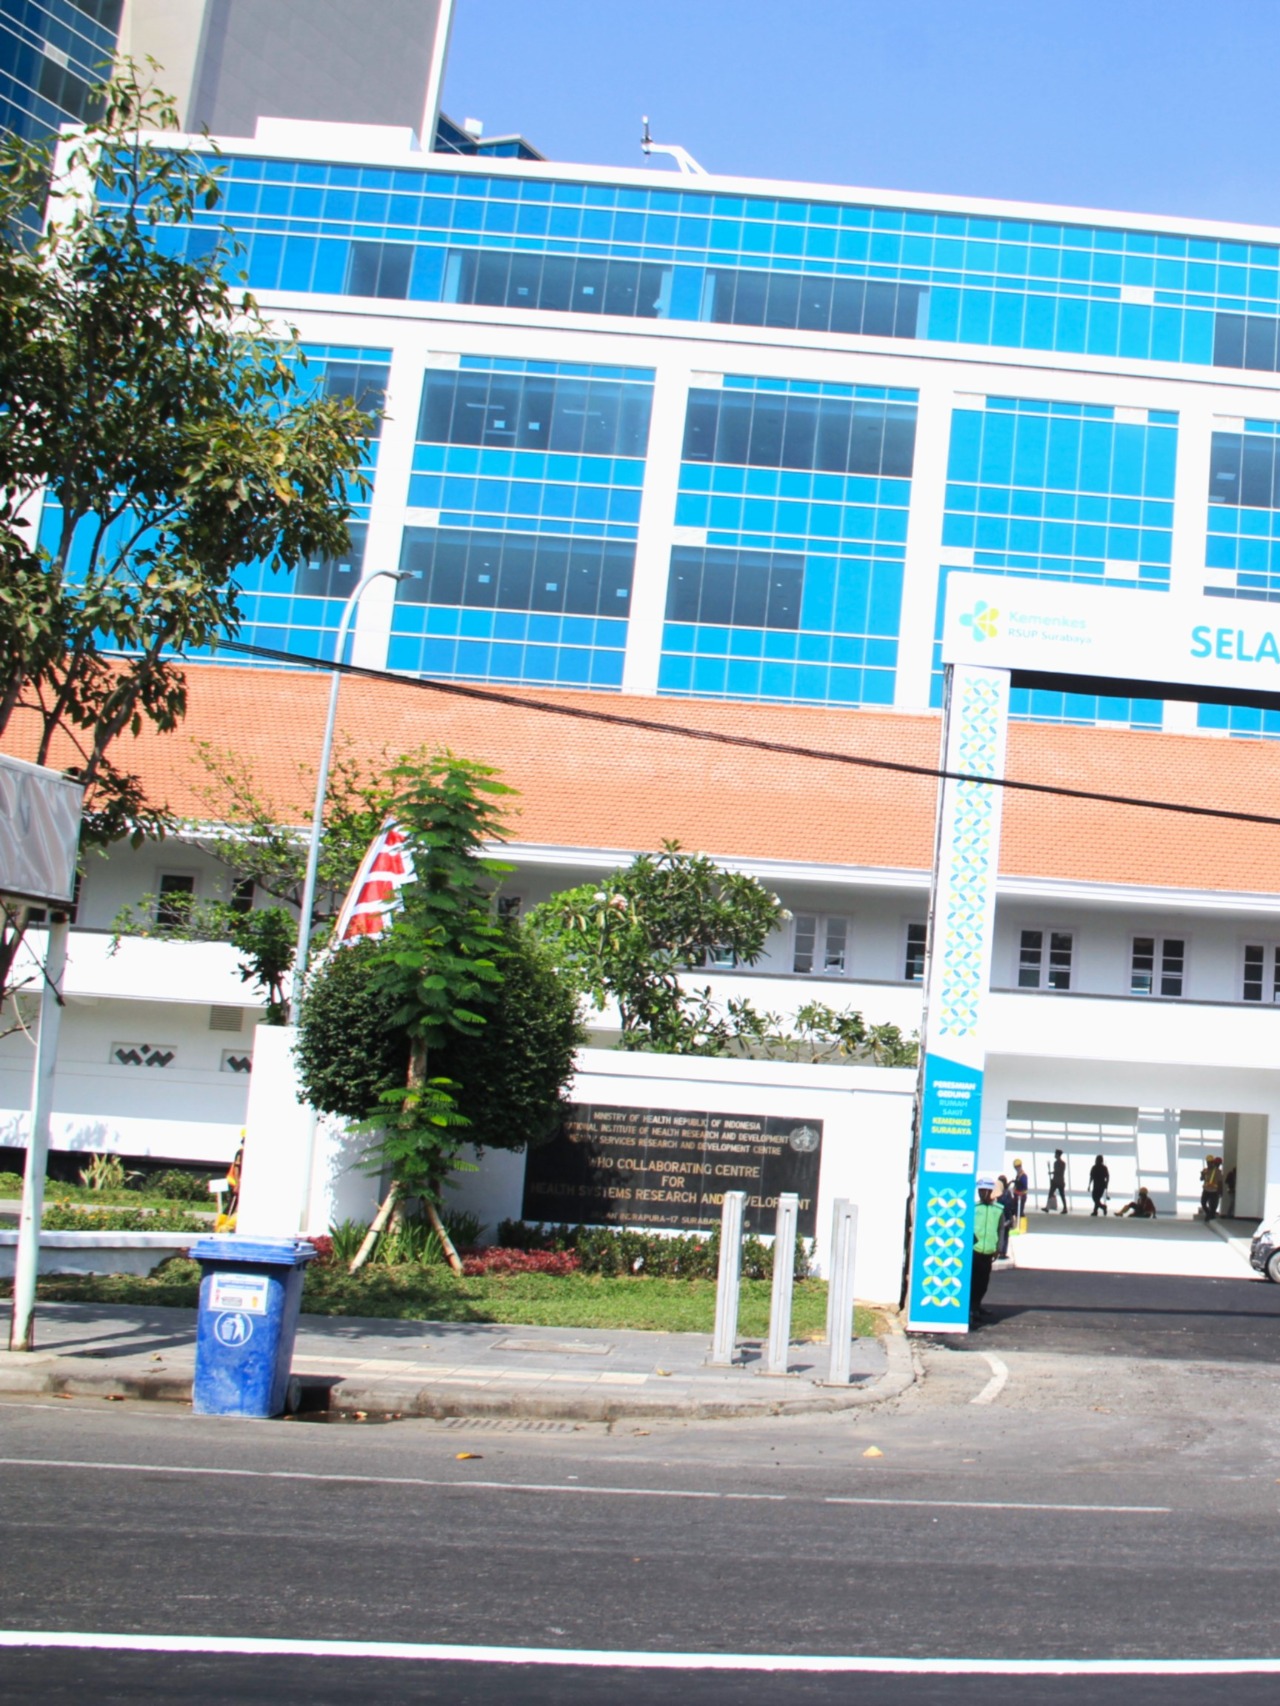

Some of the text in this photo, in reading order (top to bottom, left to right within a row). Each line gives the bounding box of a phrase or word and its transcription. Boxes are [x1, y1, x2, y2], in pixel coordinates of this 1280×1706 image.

[1008, 611, 1087, 629] Kemenkes
[1008, 628, 1092, 645] RSUP Surabaya
[593, 1111, 626, 1121] MINISTRY
[629, 1113, 639, 1122] OF
[642, 1114, 672, 1125] HEALTH
[711, 1119, 722, 1128] OF
[724, 1120, 761, 1130] INDONESIA
[639, 1126, 649, 1135] OF
[652, 1127, 680, 1137] HEALTH
[681, 1129, 719, 1139] RESEARCH
[722, 1131, 736, 1141] AND
[738, 1132, 789, 1144] DEVELOPMENT
[599, 1135, 636, 1146] SERVICES
[638, 1137, 678, 1149] RESEARCH
[680, 1140, 695, 1150] AND
[697, 1142, 750, 1153] DEVELOPMENT
[753, 1146, 782, 1156] CENTRE
[617, 1158, 712, 1174] COLLABORATING
[715, 1164, 761, 1178] CENTRE
[661, 1175, 685, 1188] FOR
[635, 1189, 697, 1203] RESEARCH
[701, 1192, 723, 1205] AND
